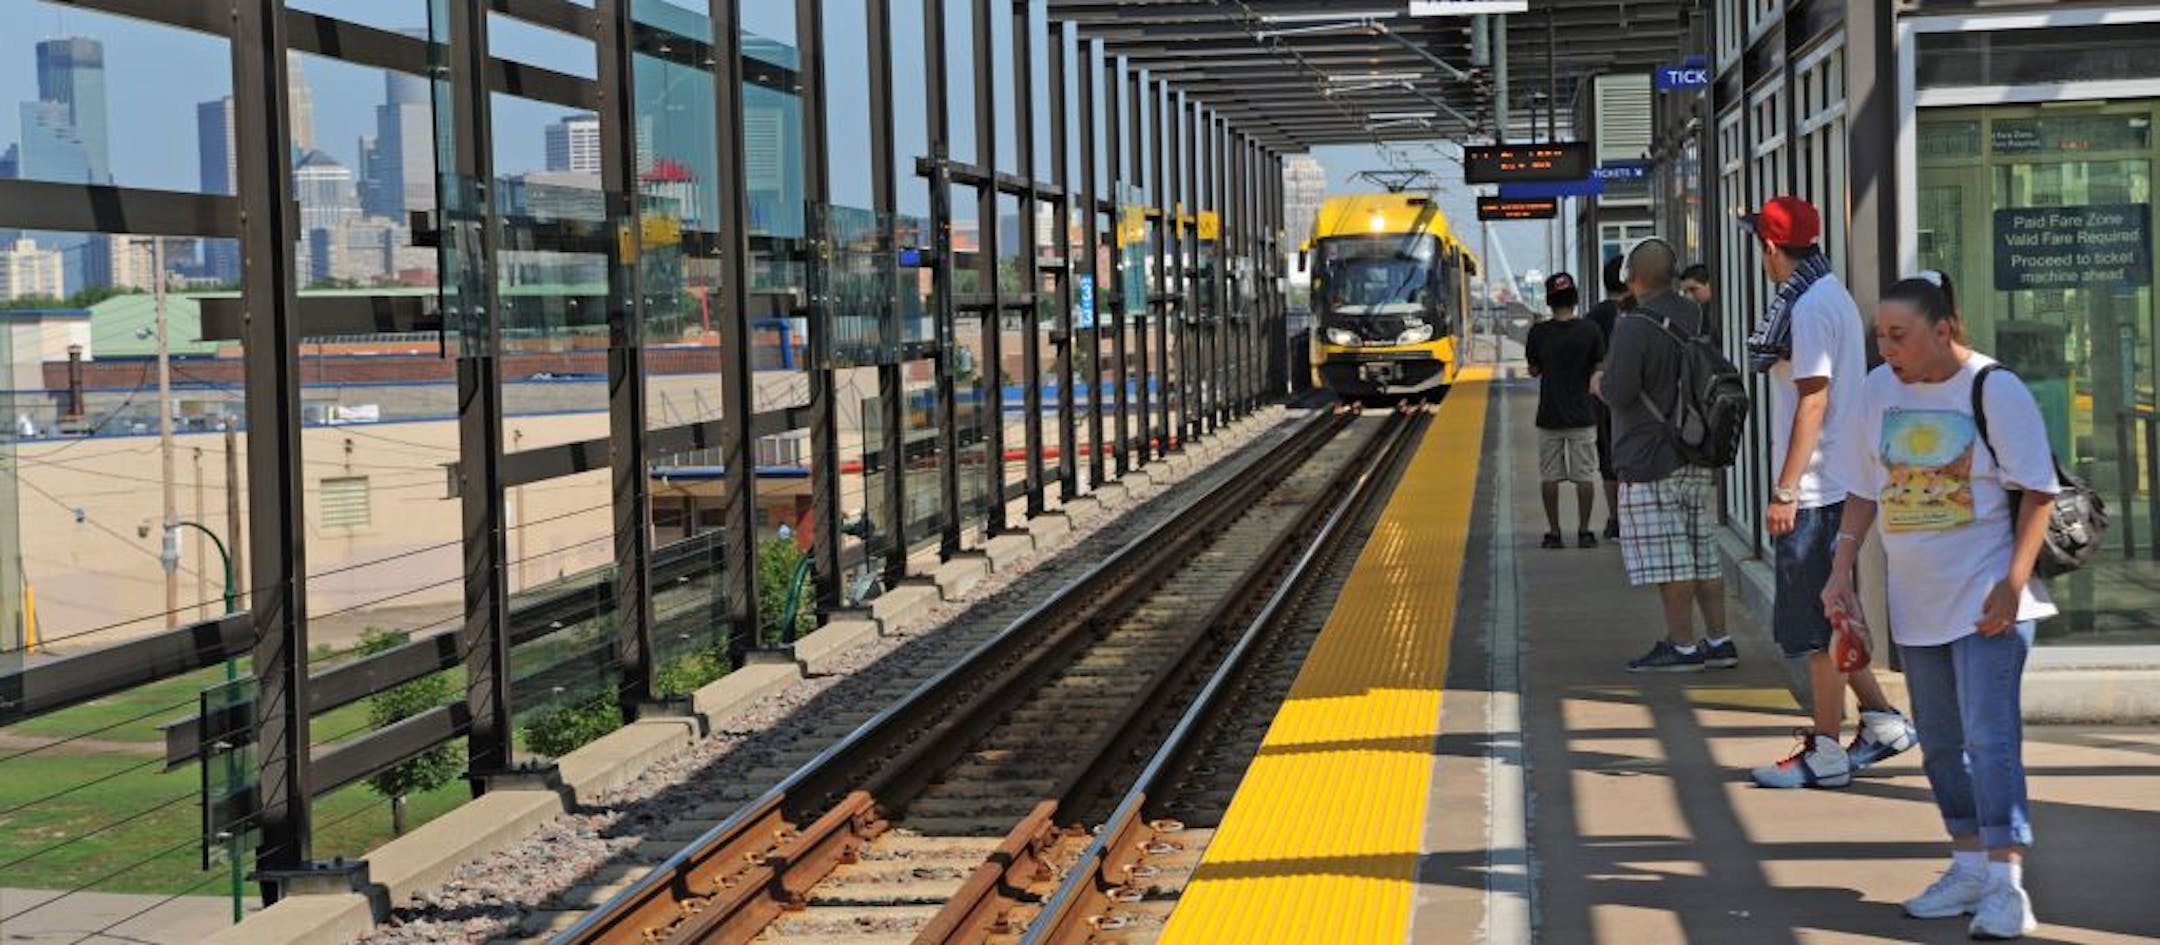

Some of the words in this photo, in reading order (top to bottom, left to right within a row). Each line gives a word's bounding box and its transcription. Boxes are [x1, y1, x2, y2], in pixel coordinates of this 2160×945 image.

[1593, 167, 1630, 178] TICKETS
[2013, 216, 2045, 229] Paid
[2050, 214, 2082, 227] Fare
[2087, 213, 2124, 226] Zone
[2005, 232, 2039, 246] Valid
[2042, 231, 2073, 245] Fare
[2077, 228, 2141, 246] Required
[2011, 253, 2073, 268] Proceed
[2077, 253, 2091, 265] to
[2094, 251, 2134, 264] ticket
[2020, 270, 2079, 283] machine
[2082, 268, 2125, 281] ahead
